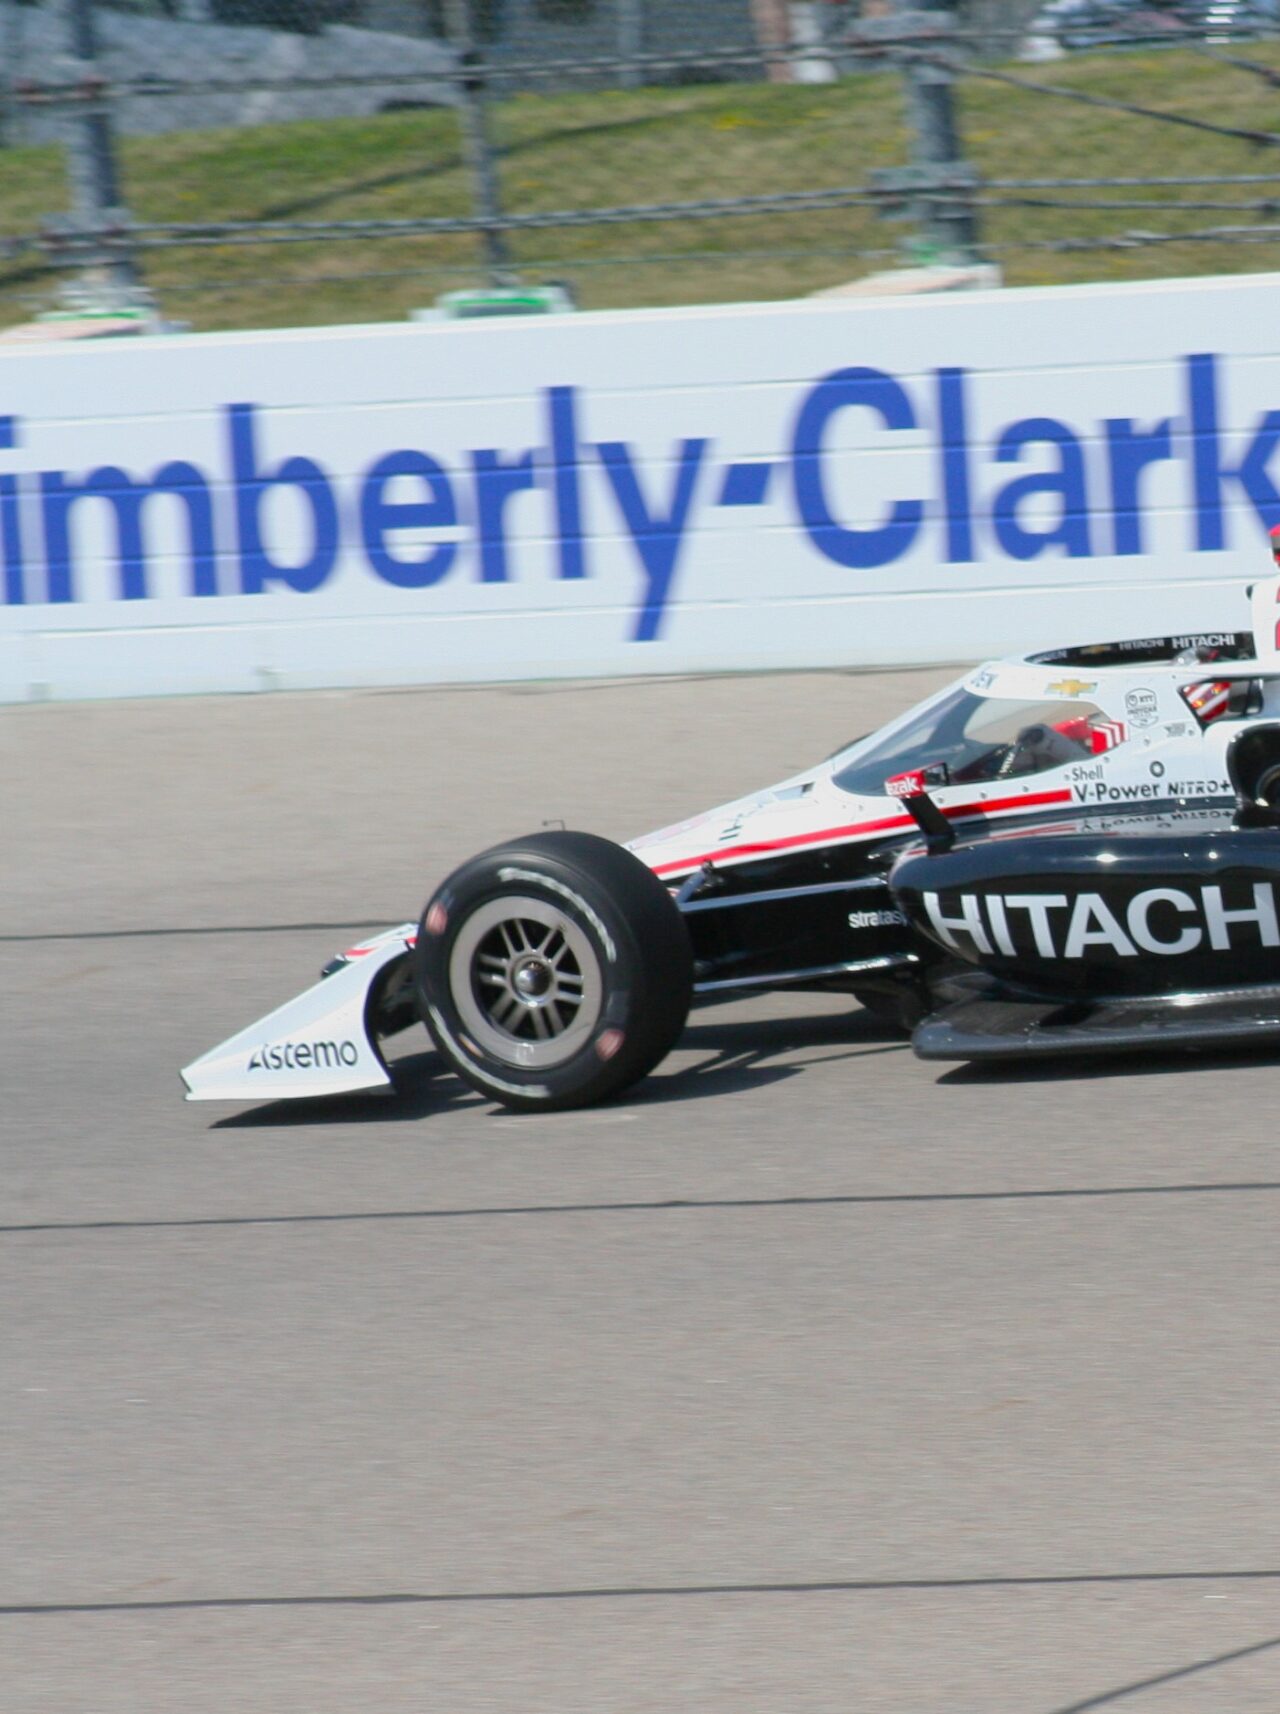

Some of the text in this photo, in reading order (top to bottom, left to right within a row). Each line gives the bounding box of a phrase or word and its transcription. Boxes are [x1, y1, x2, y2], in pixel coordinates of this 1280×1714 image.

[1171, 634, 1235, 649] HITACHI
[1071, 765, 1104, 782] Shell
[1074, 783, 1160, 803] V-Power
